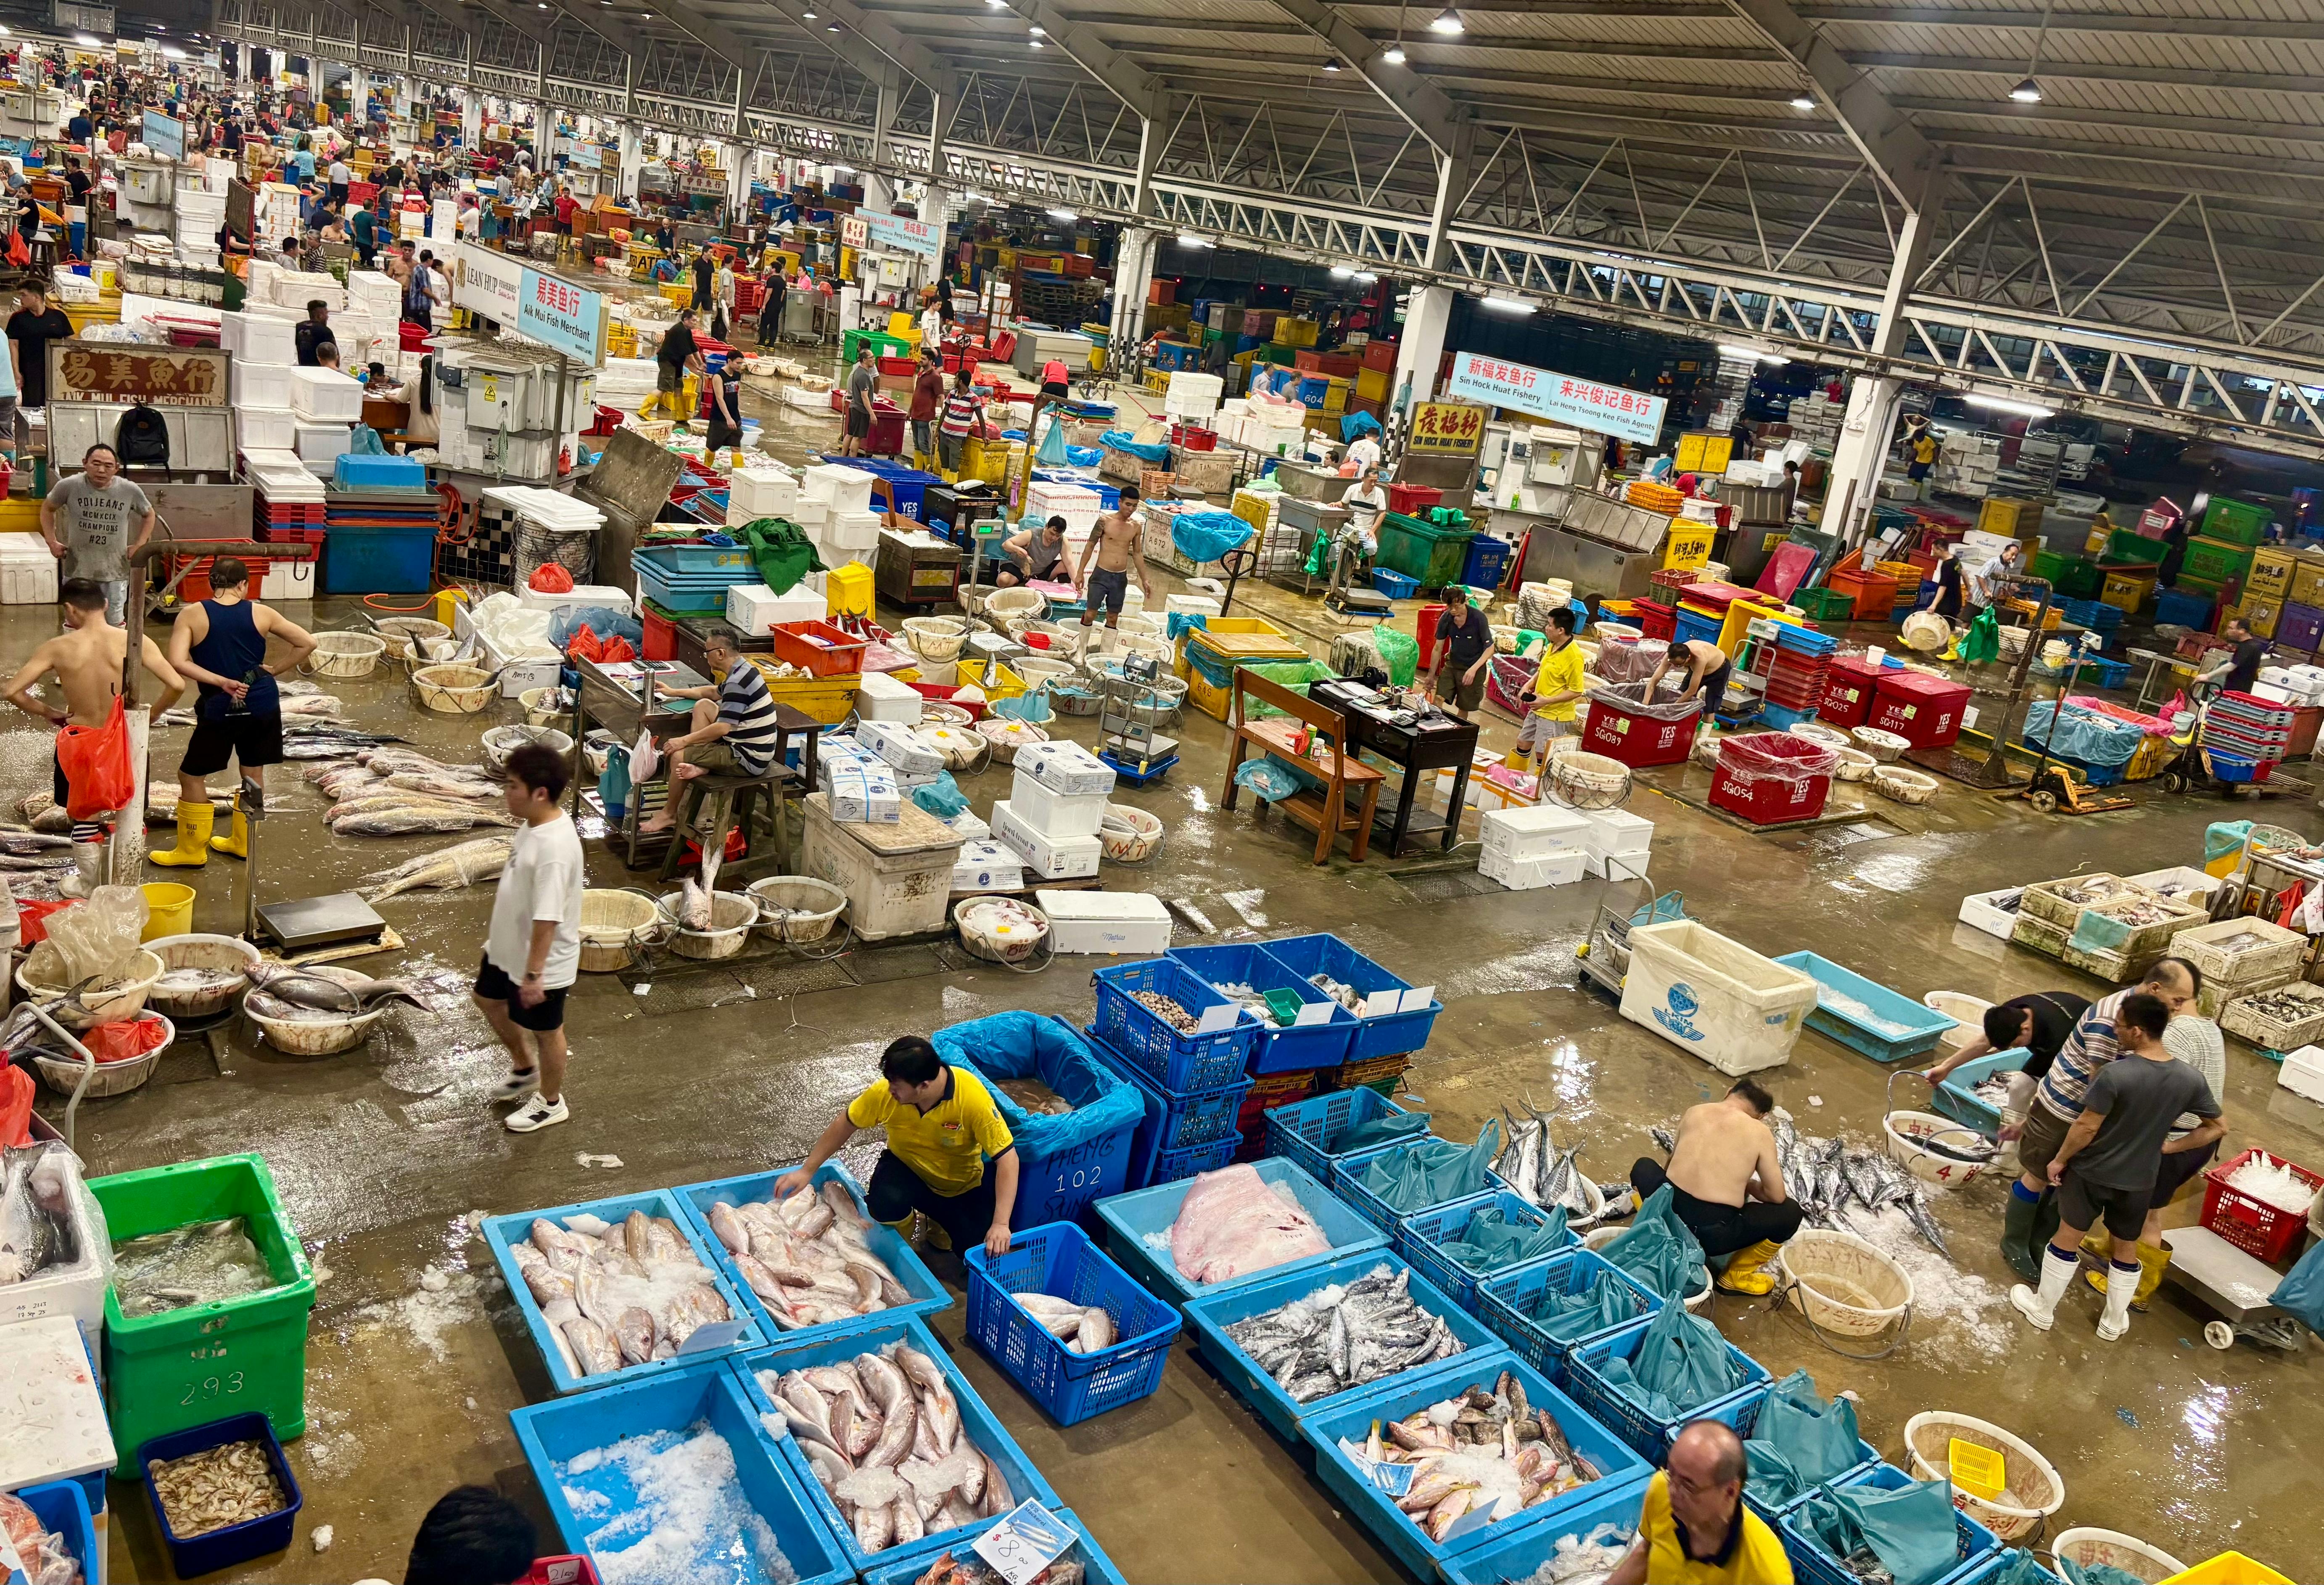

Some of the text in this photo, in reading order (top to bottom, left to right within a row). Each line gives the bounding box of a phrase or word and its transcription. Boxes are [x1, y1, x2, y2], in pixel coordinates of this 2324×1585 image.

[920, 238, 936, 247] Merchant
[467, 267, 516, 294] LEAN HUP FISHERIES
[536, 277, 580, 318] 易美鱼行
[524, 304, 590, 342] Aik Mui Fish Merchant
[65, 352, 214, 393] 易美魚行
[1468, 358, 1537, 389] 新福发鱼行
[1459, 375, 1541, 404] Sin Hock Huat Fishery
[1305, 394, 1323, 404] 604
[1560, 379, 1651, 415] 来兴俊记鱼行
[1561, 402, 1576, 413] Heng
[1578, 406, 1600, 418] Tsoong
[1603, 410, 1614, 421] Kee
[1617, 415, 1630, 424] Fish
[1632, 419, 1655, 431] Agents
[1413, 436, 1474, 448] SIN HOCK HUAT FISHERY
[78, 497, 124, 511] POIJEANS
[902, 502, 918, 513] YES
[82, 510, 116, 521] MCMXCIX
[78, 521, 118, 532] CHAMPIONS
[89, 534, 106, 545] #23
[1833, 686, 1849, 696] YES
[1888, 704, 1905, 714] YES
[1603, 714, 1619, 726] YES
[1939, 713, 1951, 725] YES
[1661, 725, 1676, 739] YES
[1794, 779, 1810, 794] YES
[1054, 1166, 1102, 1192] 102
[1936, 1165, 1952, 1181] 4
[180, 1371, 244, 1405] 293
[1025, 1507, 1046, 1527] Mackerel
[992, 1533, 1001, 1542] $
